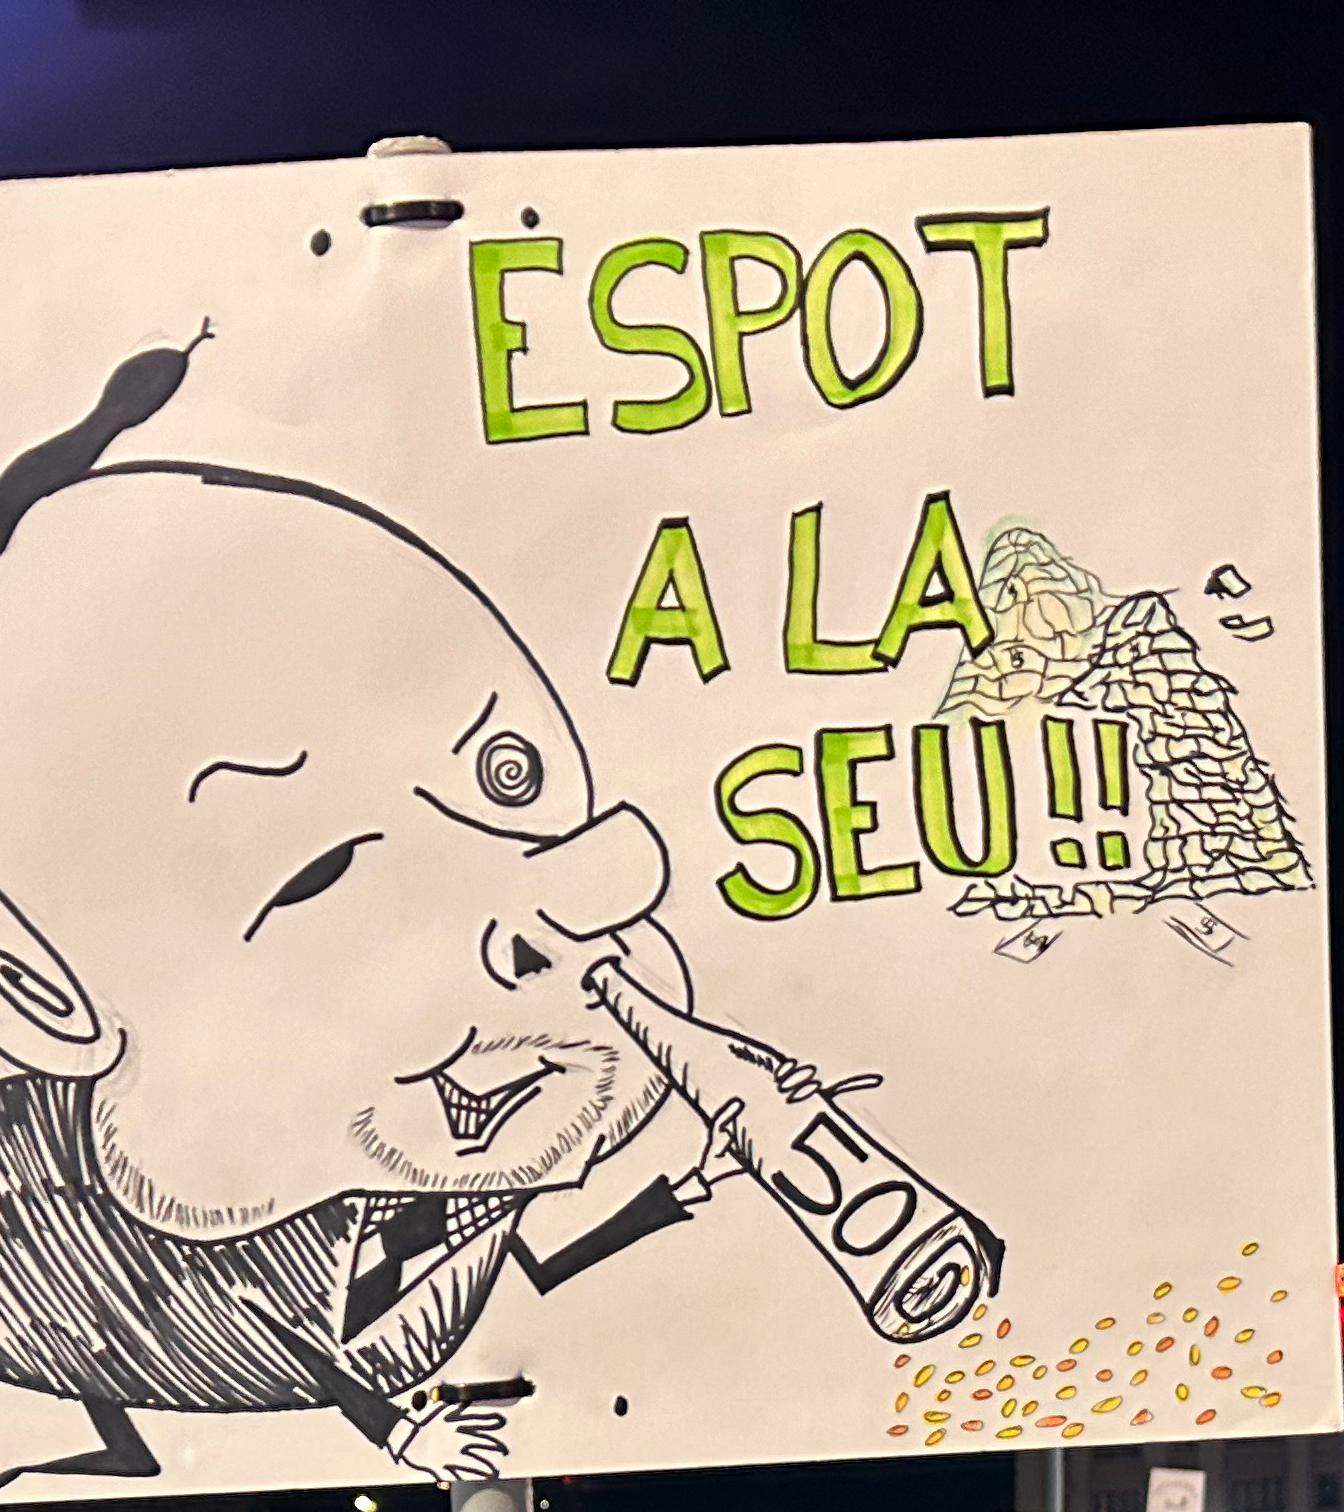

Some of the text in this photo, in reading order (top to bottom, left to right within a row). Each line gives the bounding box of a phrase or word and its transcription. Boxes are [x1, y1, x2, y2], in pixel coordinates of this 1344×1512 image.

[469, 207, 1050, 445] ESPOT
[606, 491, 997, 687] A LA
[714, 716, 1132, 922] SEU!!
